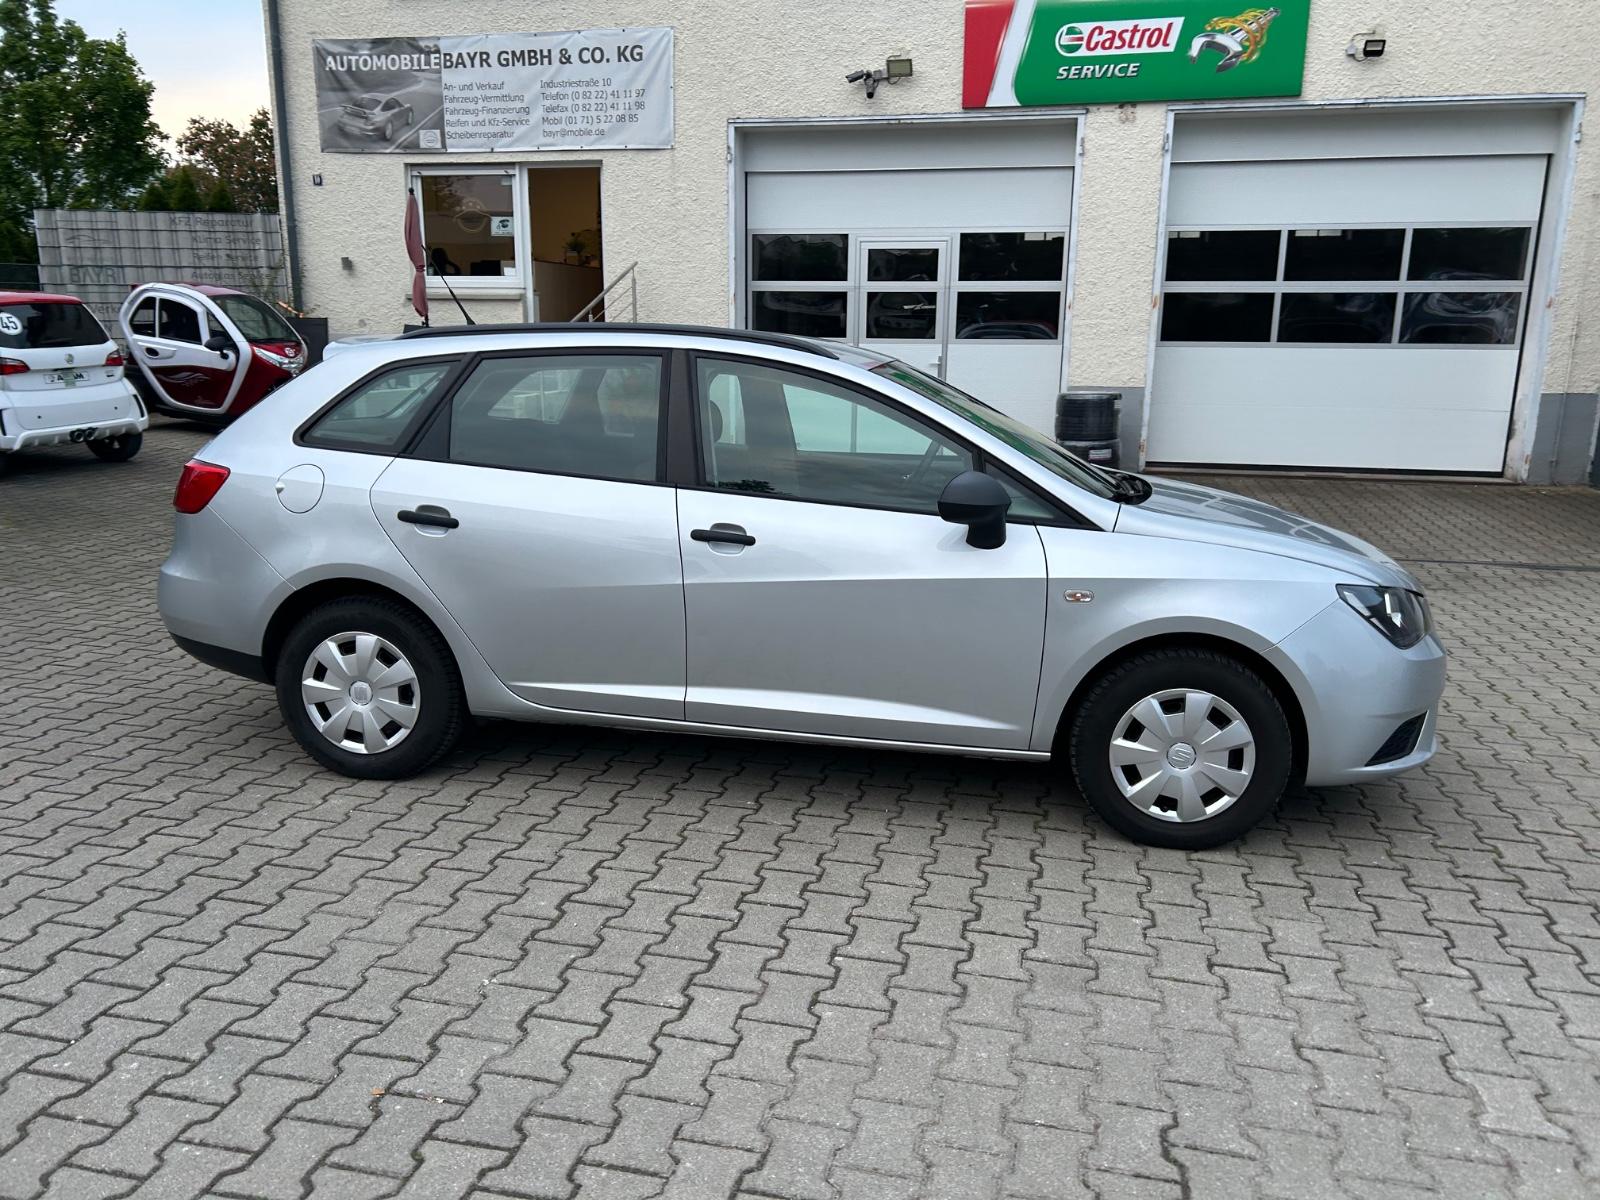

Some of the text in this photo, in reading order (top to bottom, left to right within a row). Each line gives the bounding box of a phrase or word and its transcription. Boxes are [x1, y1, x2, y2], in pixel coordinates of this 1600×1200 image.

[1085, 21, 1174, 51] Castrol
[325, 44, 644, 71] AUTOMOBILE BAYR GMBH & CO. KG
[1056, 63, 1141, 80] SERVICE
[443, 81, 504, 91] An- und Verkauf
[540, 77, 612, 89] Industriestraße 10
[444, 94, 525, 104] Fahrzeug-Vermittlung
[540, 88, 646, 102] Telefon (0 82 22) 41 11 97
[445, 106, 530, 117] Fahrzeug-Finanzierung
[541, 101, 646, 114] Telefax (0 82 22) 41 11 98
[446, 117, 530, 128] Reifen und Kfz-Service
[542, 113, 639, 126] Mobil (01 71) 5 22 08 85
[446, 130, 515, 140] Scheibenreparatur
[543, 128, 605, 139] bayr@mobile.de
[0, 315, 18, 331] 45
